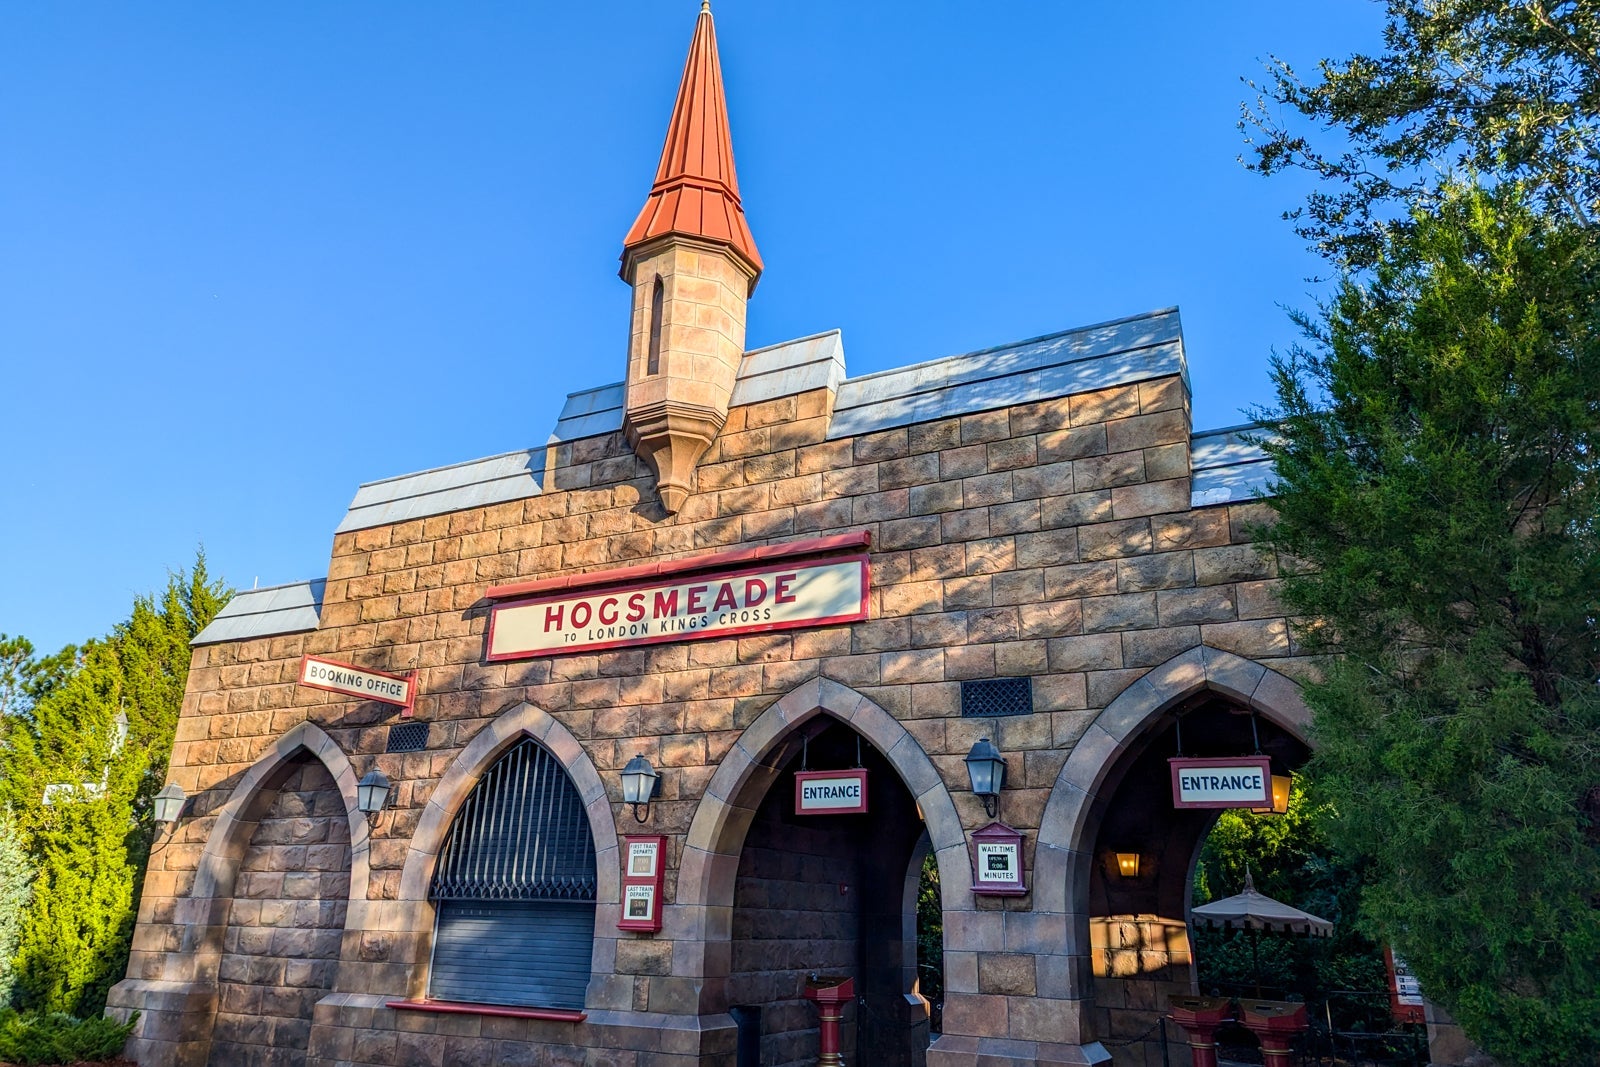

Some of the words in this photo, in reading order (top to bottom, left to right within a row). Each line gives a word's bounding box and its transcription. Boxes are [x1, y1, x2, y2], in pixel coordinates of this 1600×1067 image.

[543, 573, 797, 633] HOGSMEADE
[564, 632, 577, 643] TO
[588, 622, 649, 641] LONDON
[660, 615, 708, 633] KING'S
[719, 608, 772, 625] CROSS
[310, 665, 363, 688] BOOKING
[366, 678, 403, 697] OFFICE
[803, 785, 860, 799] ENTRANCE
[1181, 775, 1262, 791] ENTRANCE
[981, 845, 998, 853] WAIT
[999, 845, 1015, 853] TIME
